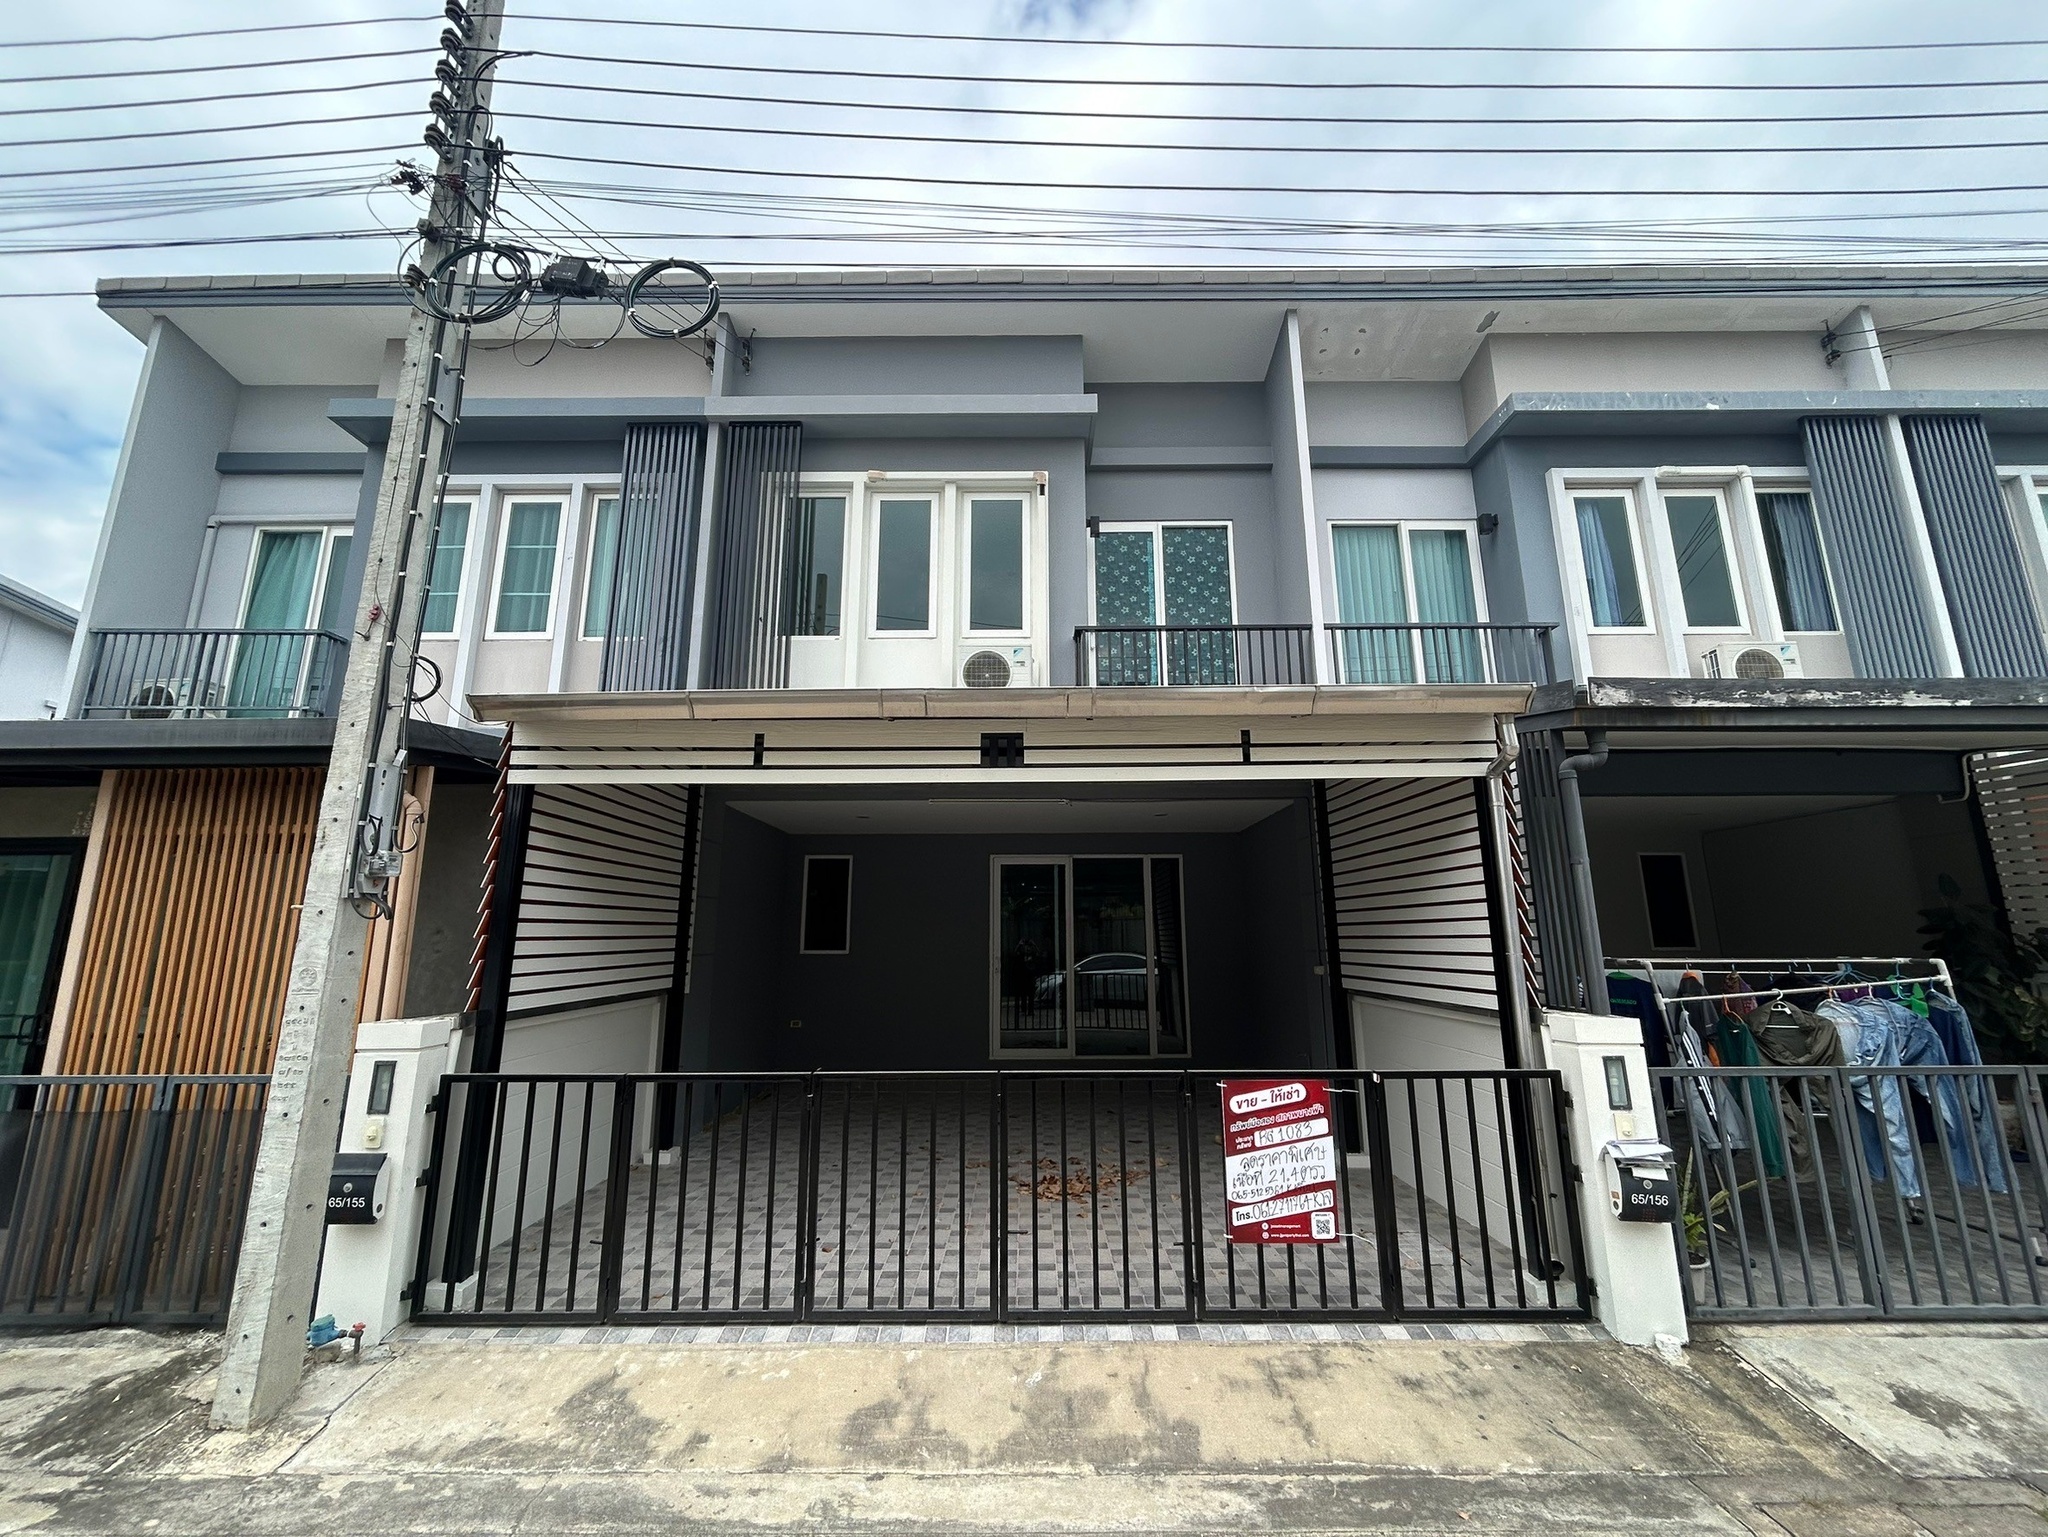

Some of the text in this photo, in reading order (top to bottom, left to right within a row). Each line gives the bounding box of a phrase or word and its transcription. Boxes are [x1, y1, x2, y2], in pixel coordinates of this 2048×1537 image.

[1236, 1097, 1258, 1109] ขาย
[1270, 1086, 1300, 1103] ให้เช่า
[328, 1197, 366, 1208] 65/155
[1631, 1193, 1669, 1206] 65/156
